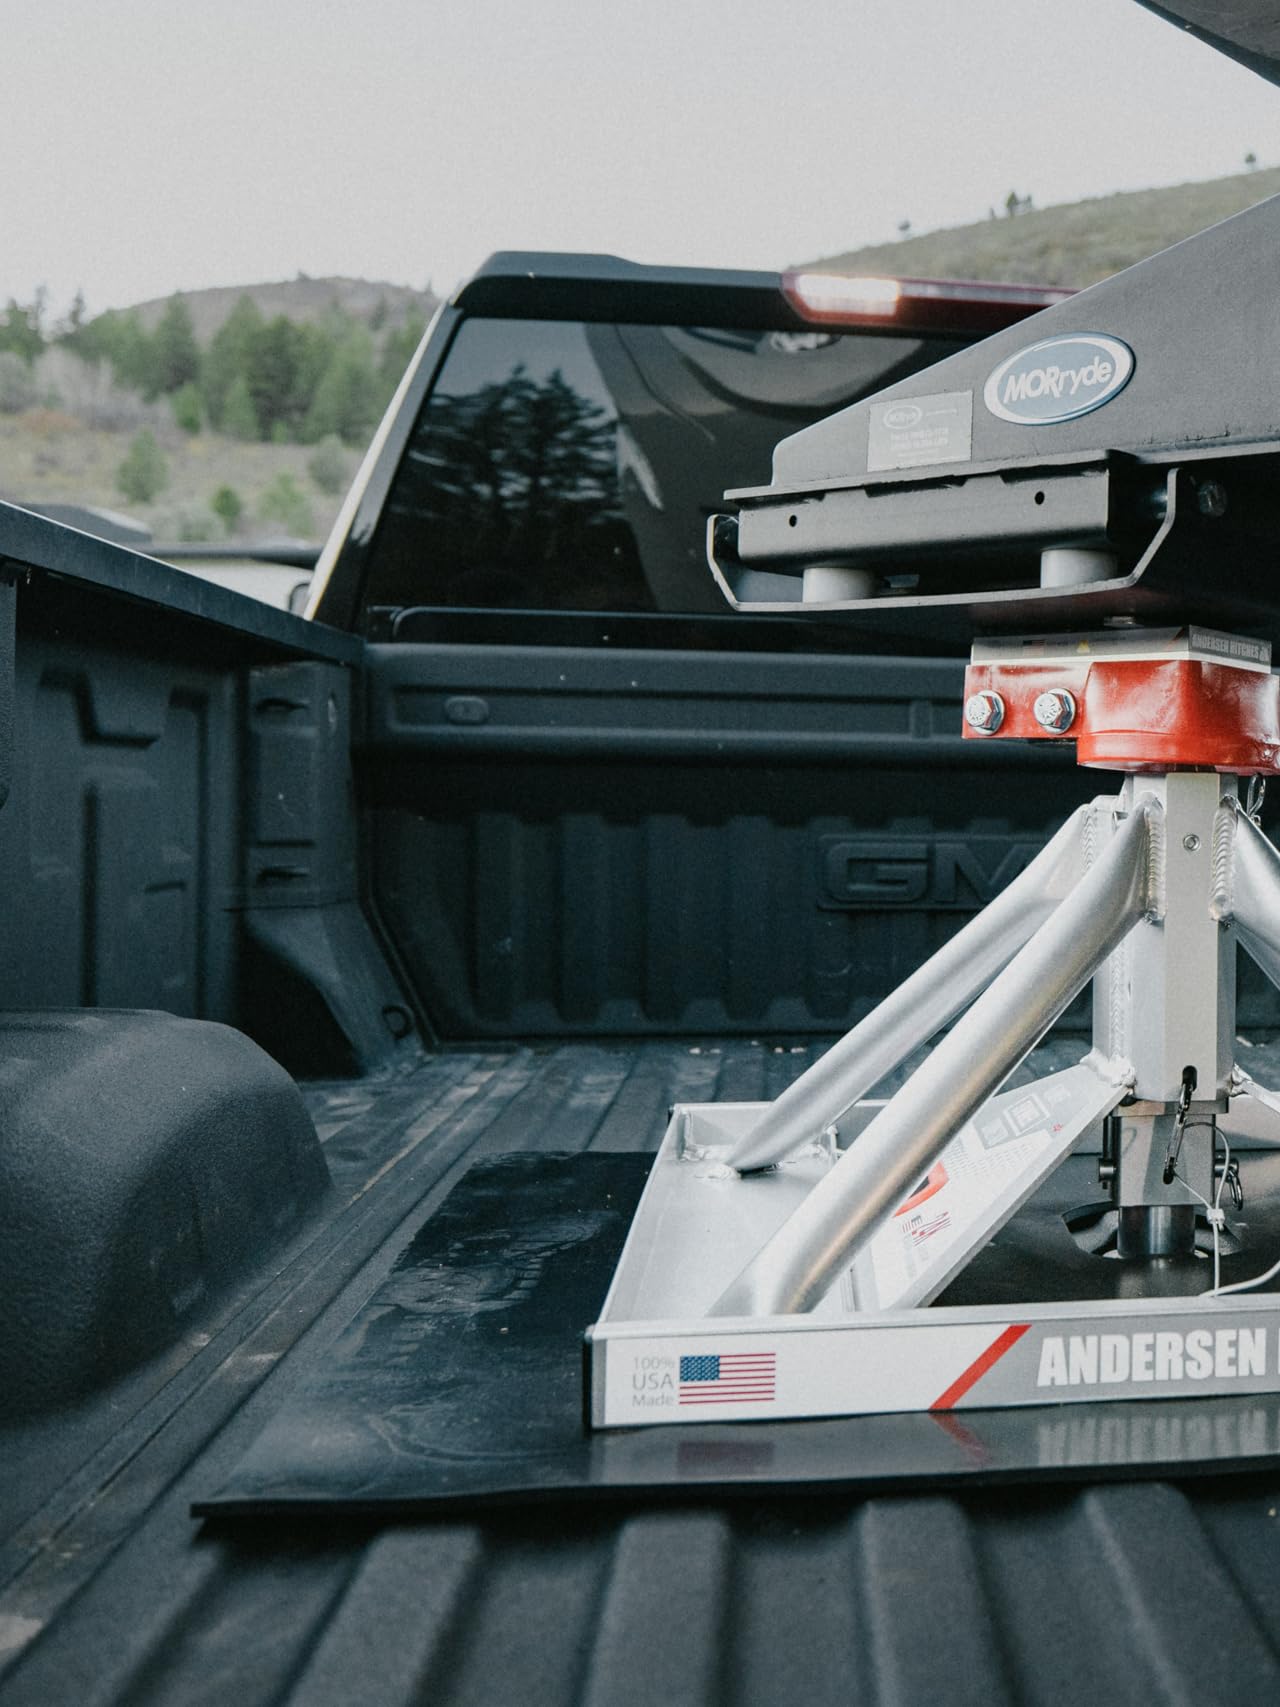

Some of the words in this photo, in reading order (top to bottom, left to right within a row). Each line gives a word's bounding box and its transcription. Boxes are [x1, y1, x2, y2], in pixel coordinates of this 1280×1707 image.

[1003, 355, 1112, 404] MORryde
[826, 842, 1044, 904] GM
[634, 1356, 676, 1370] 100%
[1037, 1327, 1267, 1387] ANDERSEN
[632, 1373, 674, 1390] USA
[632, 1393, 675, 1407] Made
